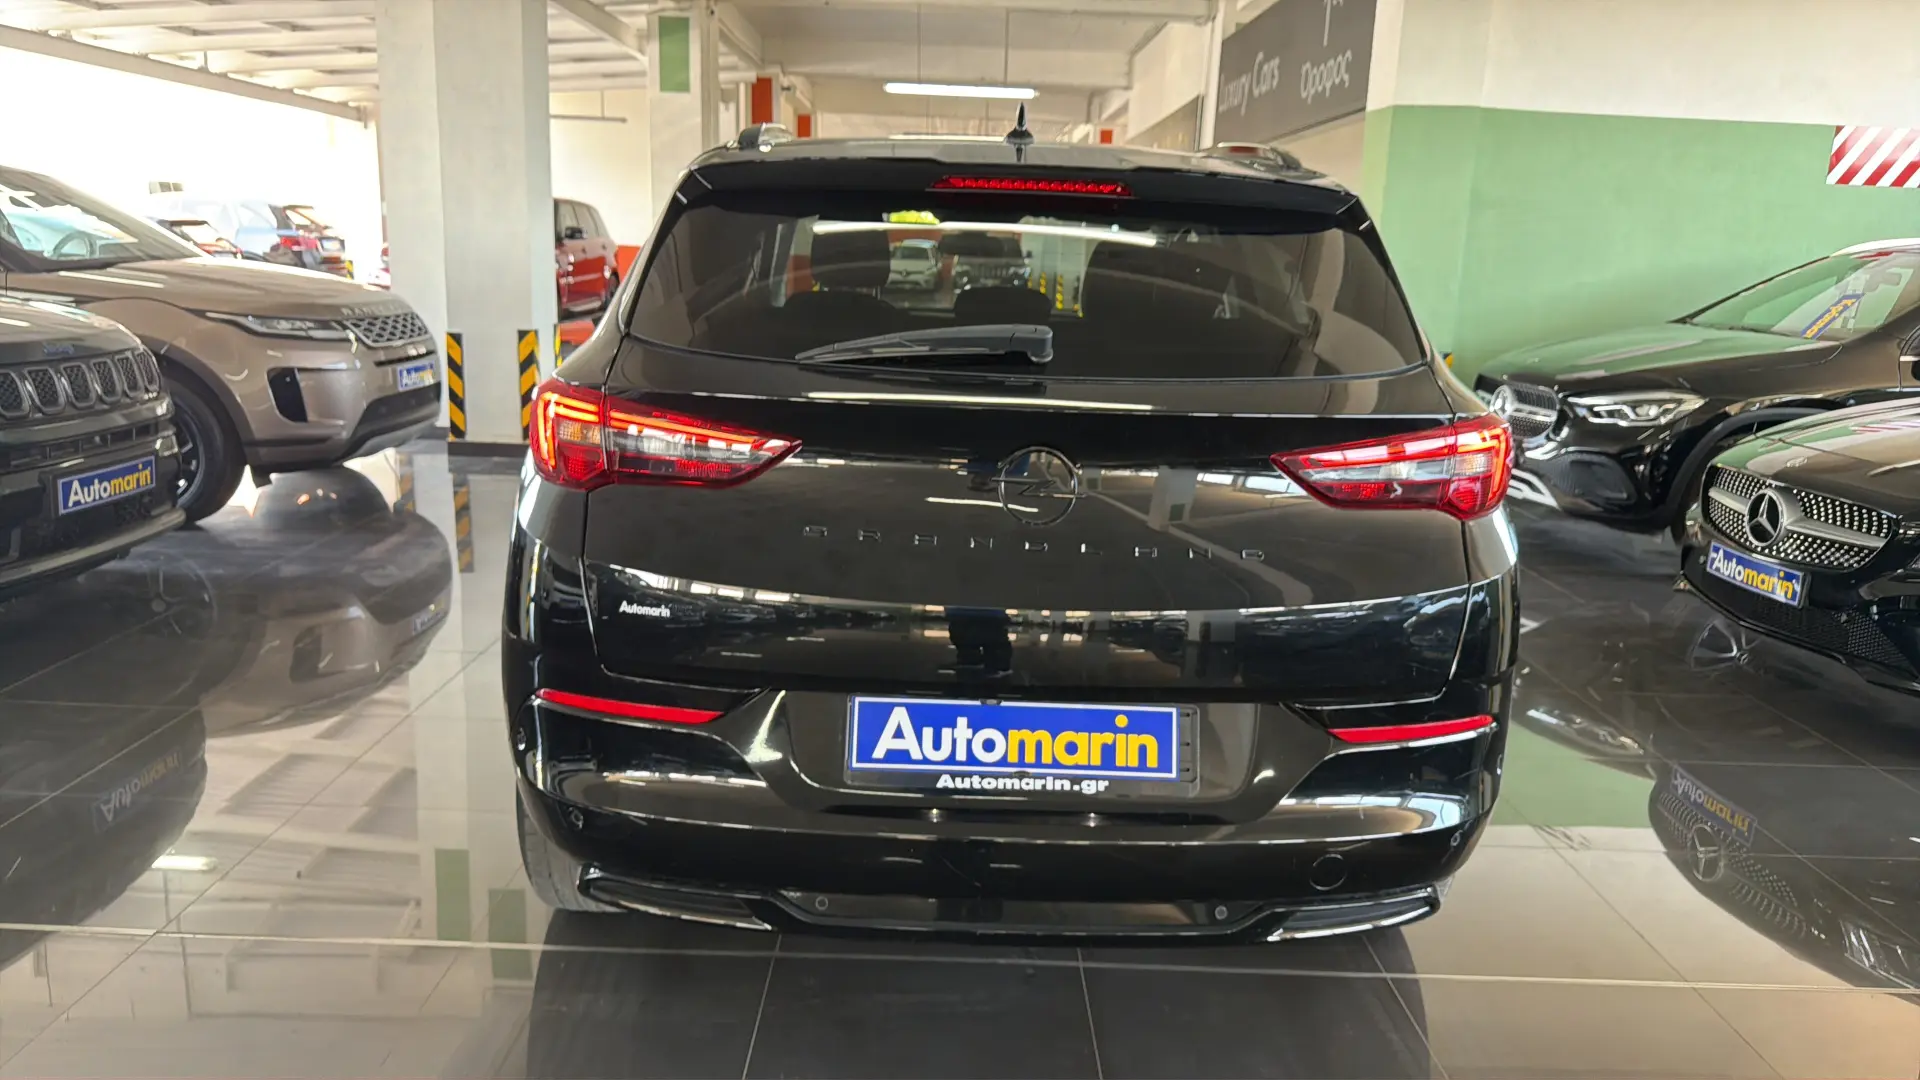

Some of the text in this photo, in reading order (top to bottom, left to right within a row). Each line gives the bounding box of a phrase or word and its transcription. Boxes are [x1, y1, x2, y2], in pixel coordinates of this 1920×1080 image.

[1252, 51, 1280, 98] Cars
[68, 463, 151, 507] Automarin
[1712, 547, 1794, 599] Automarin
[619, 600, 671, 618] Automarin
[871, 706, 1158, 769] Automarin
[936, 773, 1109, 795] Automarin.gr
